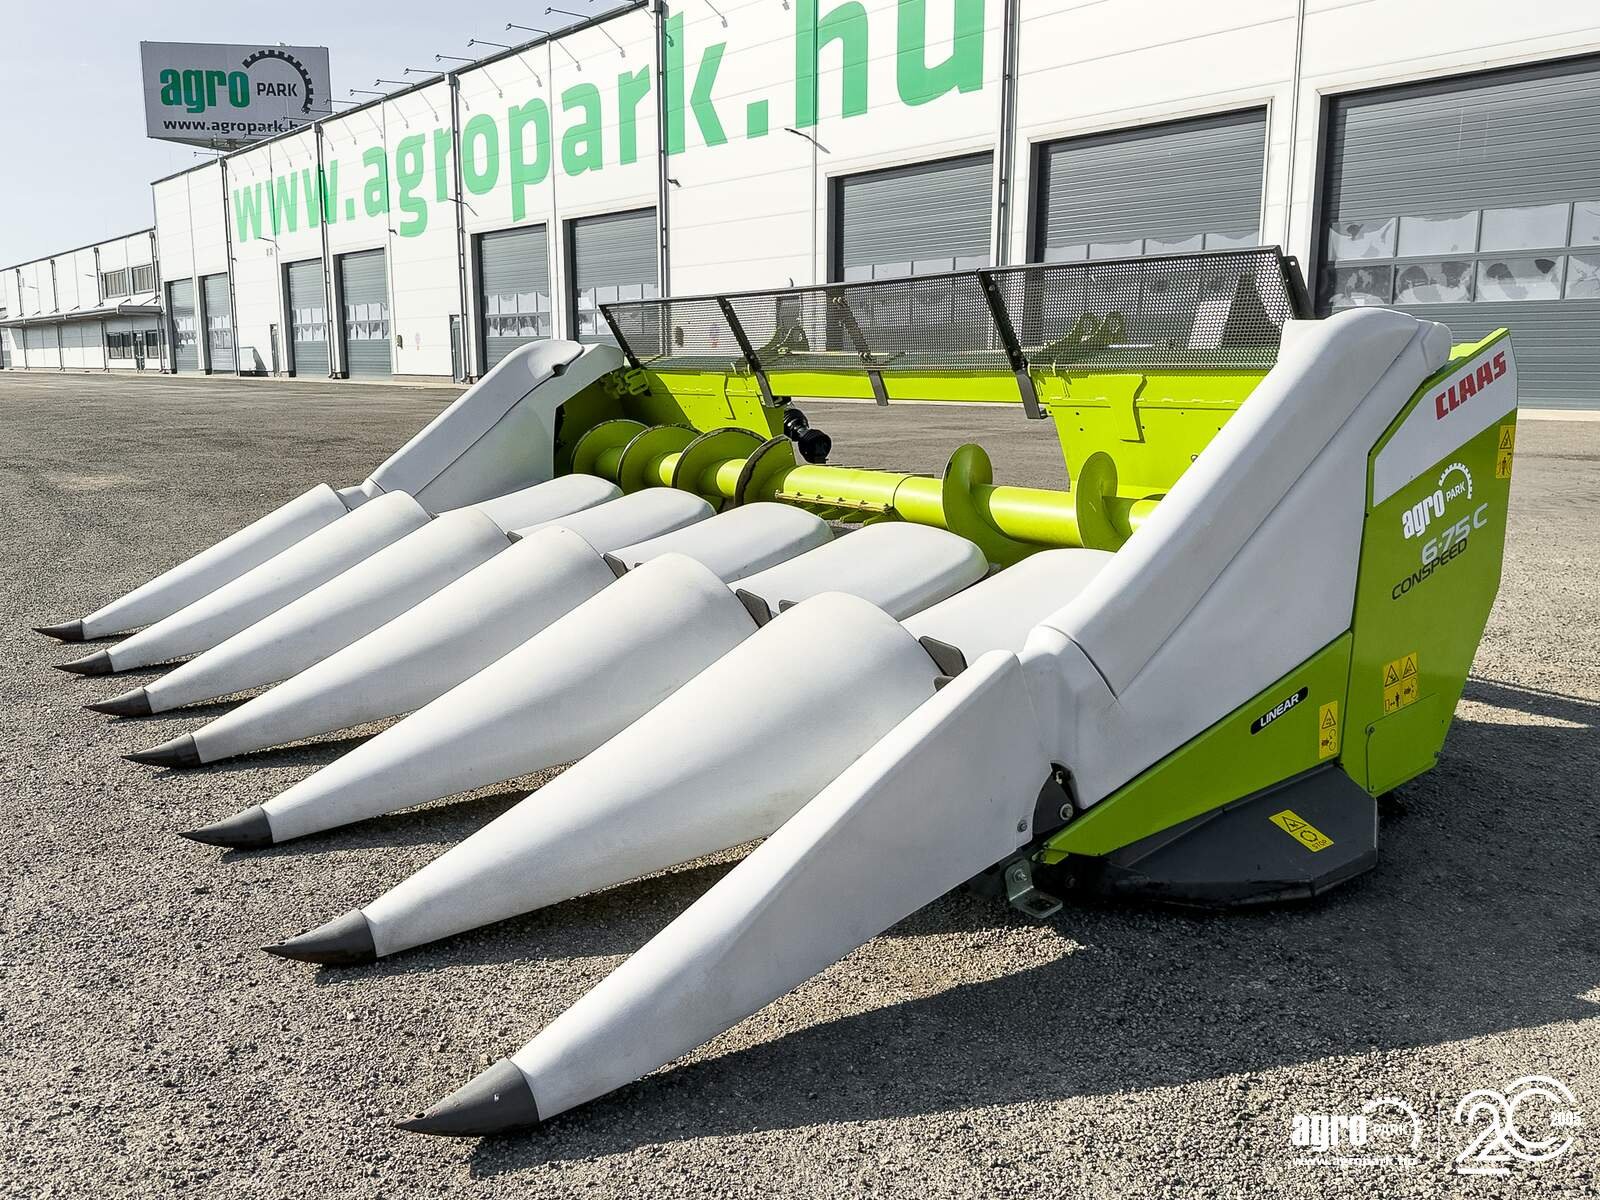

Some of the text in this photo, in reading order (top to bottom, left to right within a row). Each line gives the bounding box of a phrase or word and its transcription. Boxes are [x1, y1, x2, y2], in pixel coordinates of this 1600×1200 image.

[159, 68, 298, 113] agro PARK
[163, 119, 302, 135] www.agropark.h
[233, 0, 985, 243] www.agropark.hu
[1435, 350, 1507, 421] CLAAS
[1402, 481, 1466, 540] agro PARK
[1391, 538, 1468, 600] CONSPEED
[1260, 692, 1301, 727] LINEAR
